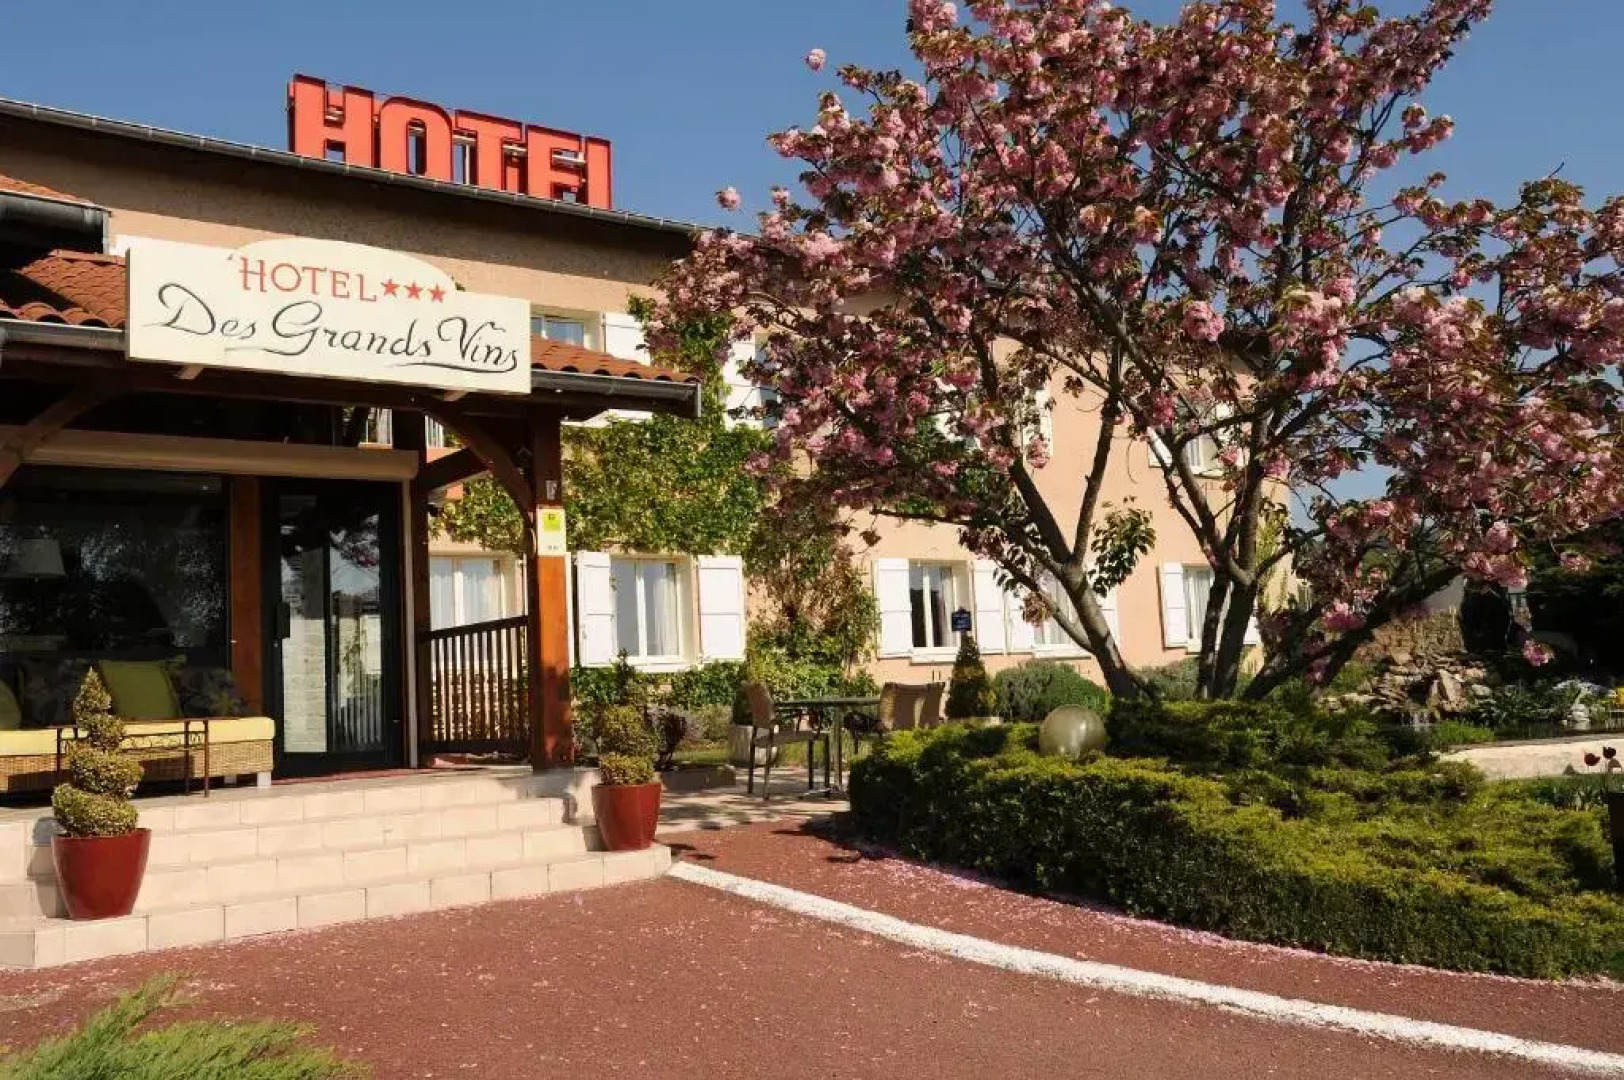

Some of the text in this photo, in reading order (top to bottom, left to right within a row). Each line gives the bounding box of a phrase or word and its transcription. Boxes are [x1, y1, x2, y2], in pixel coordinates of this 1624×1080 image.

[239, 256, 377, 303] HOTEL
[143, 282, 518, 373] Des Grands Vins
